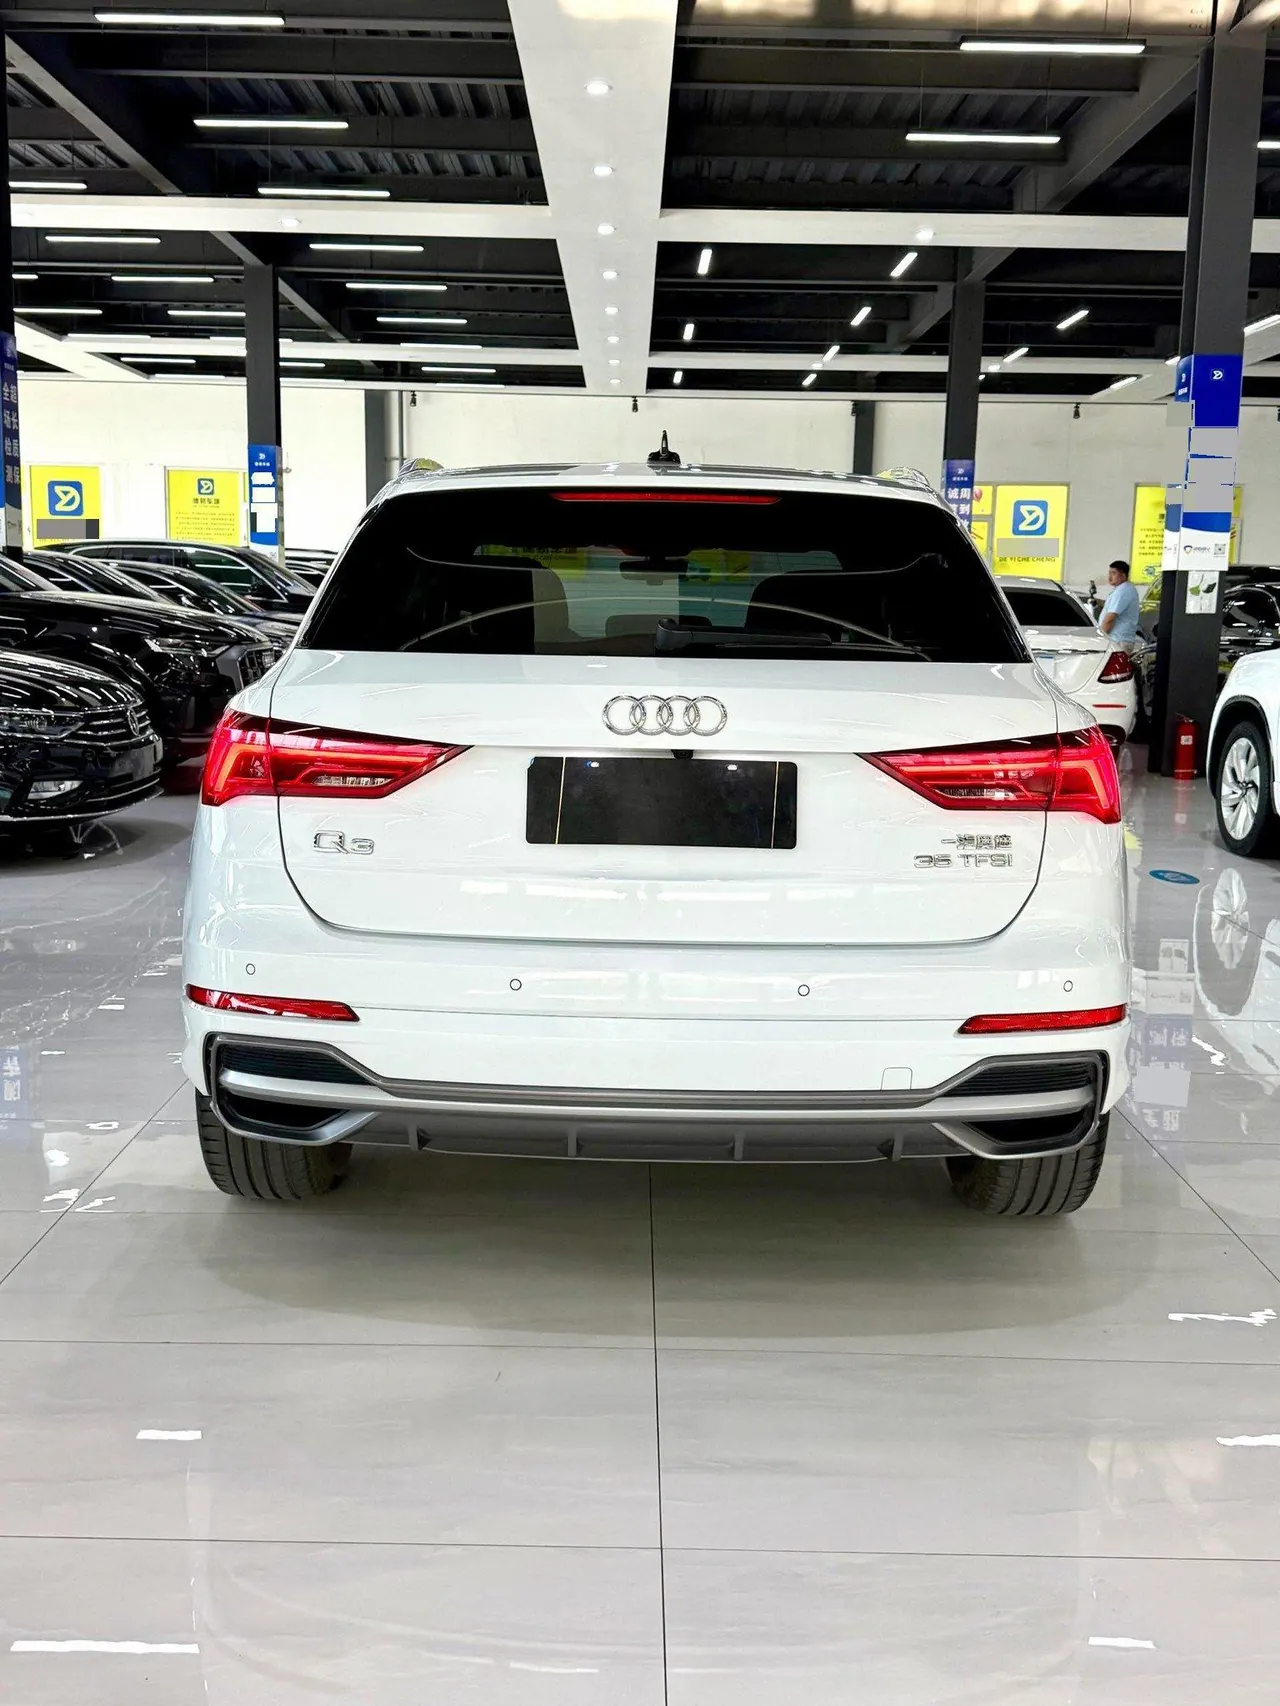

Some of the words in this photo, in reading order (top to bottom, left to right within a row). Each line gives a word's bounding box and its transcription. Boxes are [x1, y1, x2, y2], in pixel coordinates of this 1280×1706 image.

[313, 830, 374, 855] Q3
[914, 853, 952, 868] 35
[957, 853, 1013, 867] TFSI
